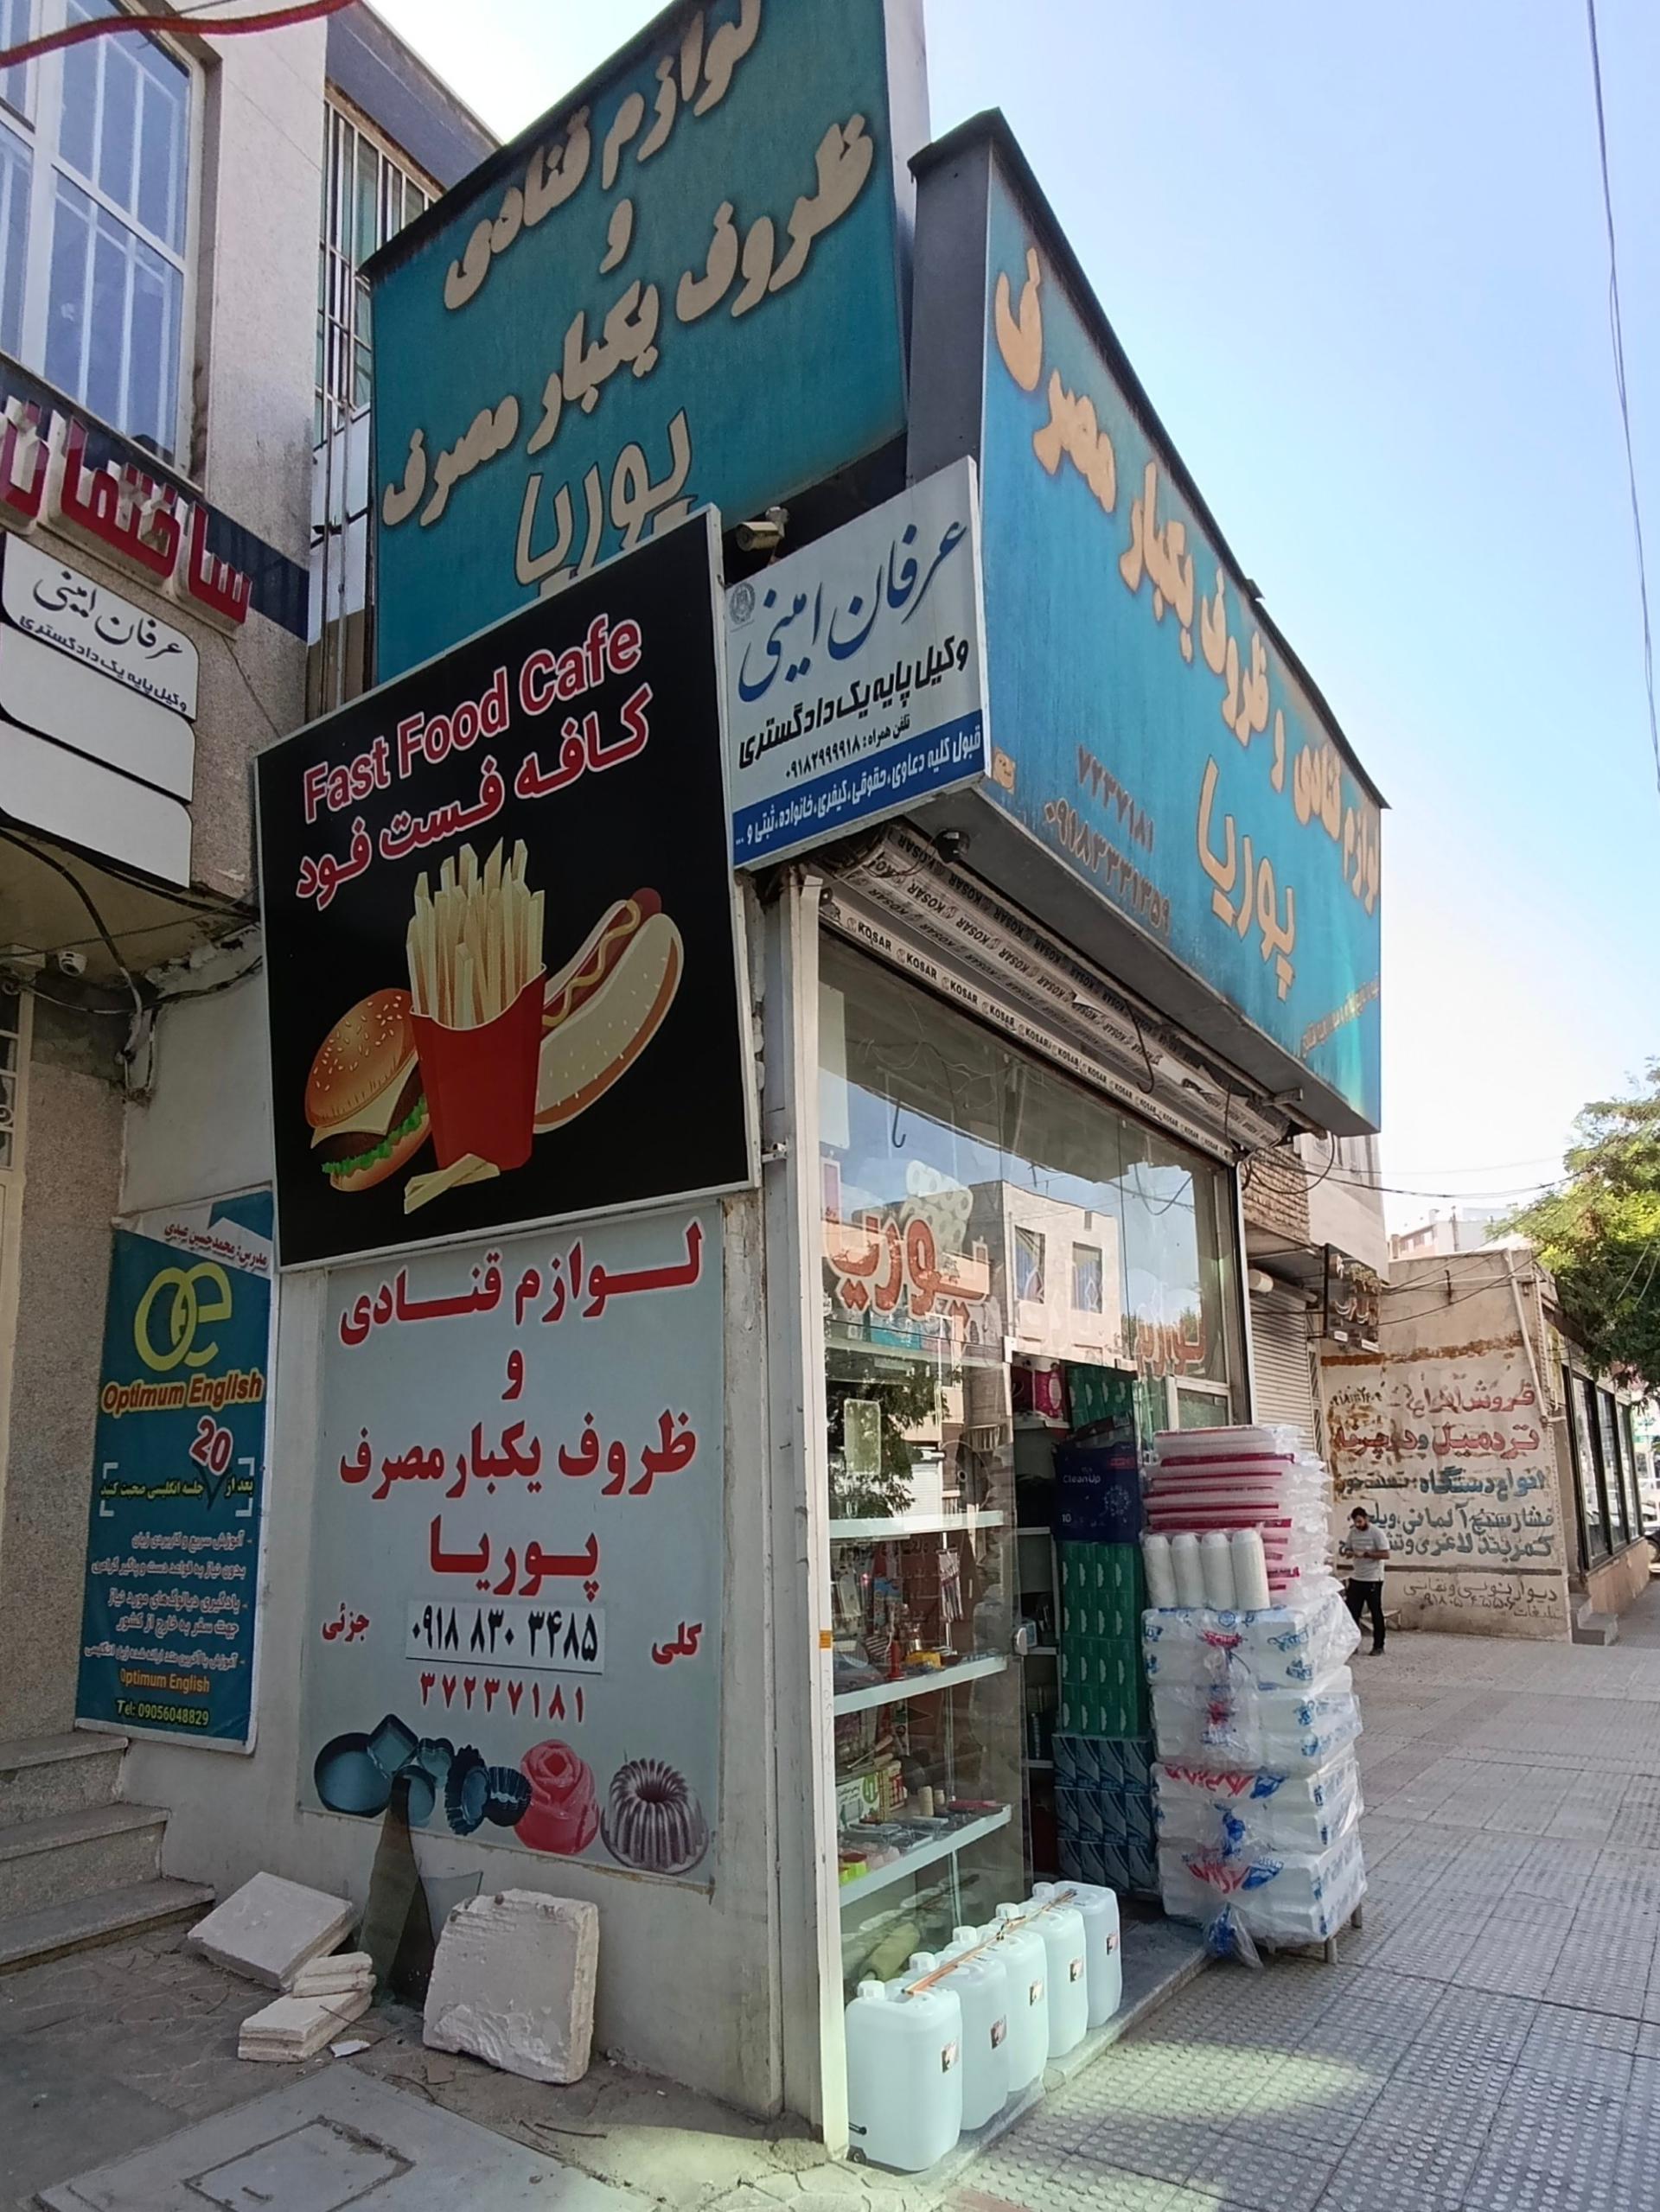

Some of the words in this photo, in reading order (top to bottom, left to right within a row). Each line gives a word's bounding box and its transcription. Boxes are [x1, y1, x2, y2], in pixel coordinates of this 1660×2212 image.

[602, 0, 760, 190] لوازم
[444, 105, 591, 310] قنادی
[676, 113, 874, 322] ظروف
[599, 198, 633, 274] و
[527, 279, 661, 456] یکبار
[994, 246, 1117, 513] مصرف
[382, 394, 520, 527] مصرف
[514, 406, 698, 599] پوریا
[1119, 461, 1194, 664] یکبار
[32, 571, 97, 619] امینی
[827, 520, 969, 660] عرفان
[19, 615, 99, 663] دادگستری
[93, 616, 183, 662] عرفان
[737, 582, 822, 703] امینی
[914, 635, 970, 688] وکیل
[1199, 566, 1269, 747] ظروف
[99, 659, 127, 680] یک
[126, 669, 155, 698] پایه
[873, 661, 912, 709] پایه
[155, 686, 188, 713] وکیل
[303, 735, 390, 824] Fast
[397, 666, 510, 779] Food
[520, 613, 642, 716] Cafe
[837, 679, 872, 721] یک
[514, 682, 653, 800] کافه
[738, 697, 833, 769] دادگستری
[892, 714, 911, 739] تلفن
[952, 724, 981, 764] قبول
[927, 737, 951, 772] کلیه
[379, 755, 506, 861] فست
[1293, 743, 1341, 842] قنادی
[746, 822, 754, 846] و
[754, 803, 776, 844] ثبتی
[295, 817, 374, 912] فود
[1196, 753, 1295, 1002] پوریا
[907, 882, 946, 914] KOSAR
[955, 916, 993, 945] KOSAR
[998, 947, 1031, 973] KOSAR
[1037, 975, 1066, 998] KOSAR
[948, 875, 984, 905] KOSAR
[993, 907, 1025, 937] KOSAR
[1034, 935, 1062, 964] KOSAR
[858, 921, 892, 952] KOSAR
[906, 953, 937, 979] KOSAR
[949, 979, 979, 1004] KOSAR
[989, 1004, 1015, 1026] KOSAR
[515, 1221, 706, 1327] لوازم
[340, 1251, 502, 1346] قنادی
[102, 1379, 185, 1418] Optimum
[187, 1367, 264, 1412] English
[501, 1348, 525, 1400] و
[1461, 1379, 1536, 1414] فروش
[189, 1414, 233, 1476] 20
[339, 1426, 445, 1501] مصرف
[445, 1419, 542, 1499] یکبار
[558, 1409, 697, 1496] ظروف
[100, 1480, 119, 1500] کنید
[119, 1482, 145, 1500] صحبت
[182, 1481, 204, 1500] جلسه
[226, 1474, 235, 1497] از
[236, 1477, 253, 1495] بعد
[1495, 1466, 1546, 1502] انواع
[212, 1529, 246, 1552] آموزش
[429, 1514, 601, 1604] پوریا
[1414, 1532, 1474, 1556] لاغری
[1478, 1529, 1555, 1563] کمربند
[221, 1563, 246, 1581] بدون
[115, 1611, 144, 1633] کشور
[190, 1616, 214, 1637] سفر
[200, 1590, 240, 1615] یادگیری
[322, 1602, 371, 1642] جزئی
[155, 1614, 178, 1640] خارج
[214, 1618, 239, 1640] جهت
[651, 1621, 703, 1666] کلی
[120, 1667, 168, 1689] Optimum
[169, 1672, 211, 1695] English
[116, 1699, 136, 1717] Tel:
[137, 1701, 210, 1727] 09056048829
